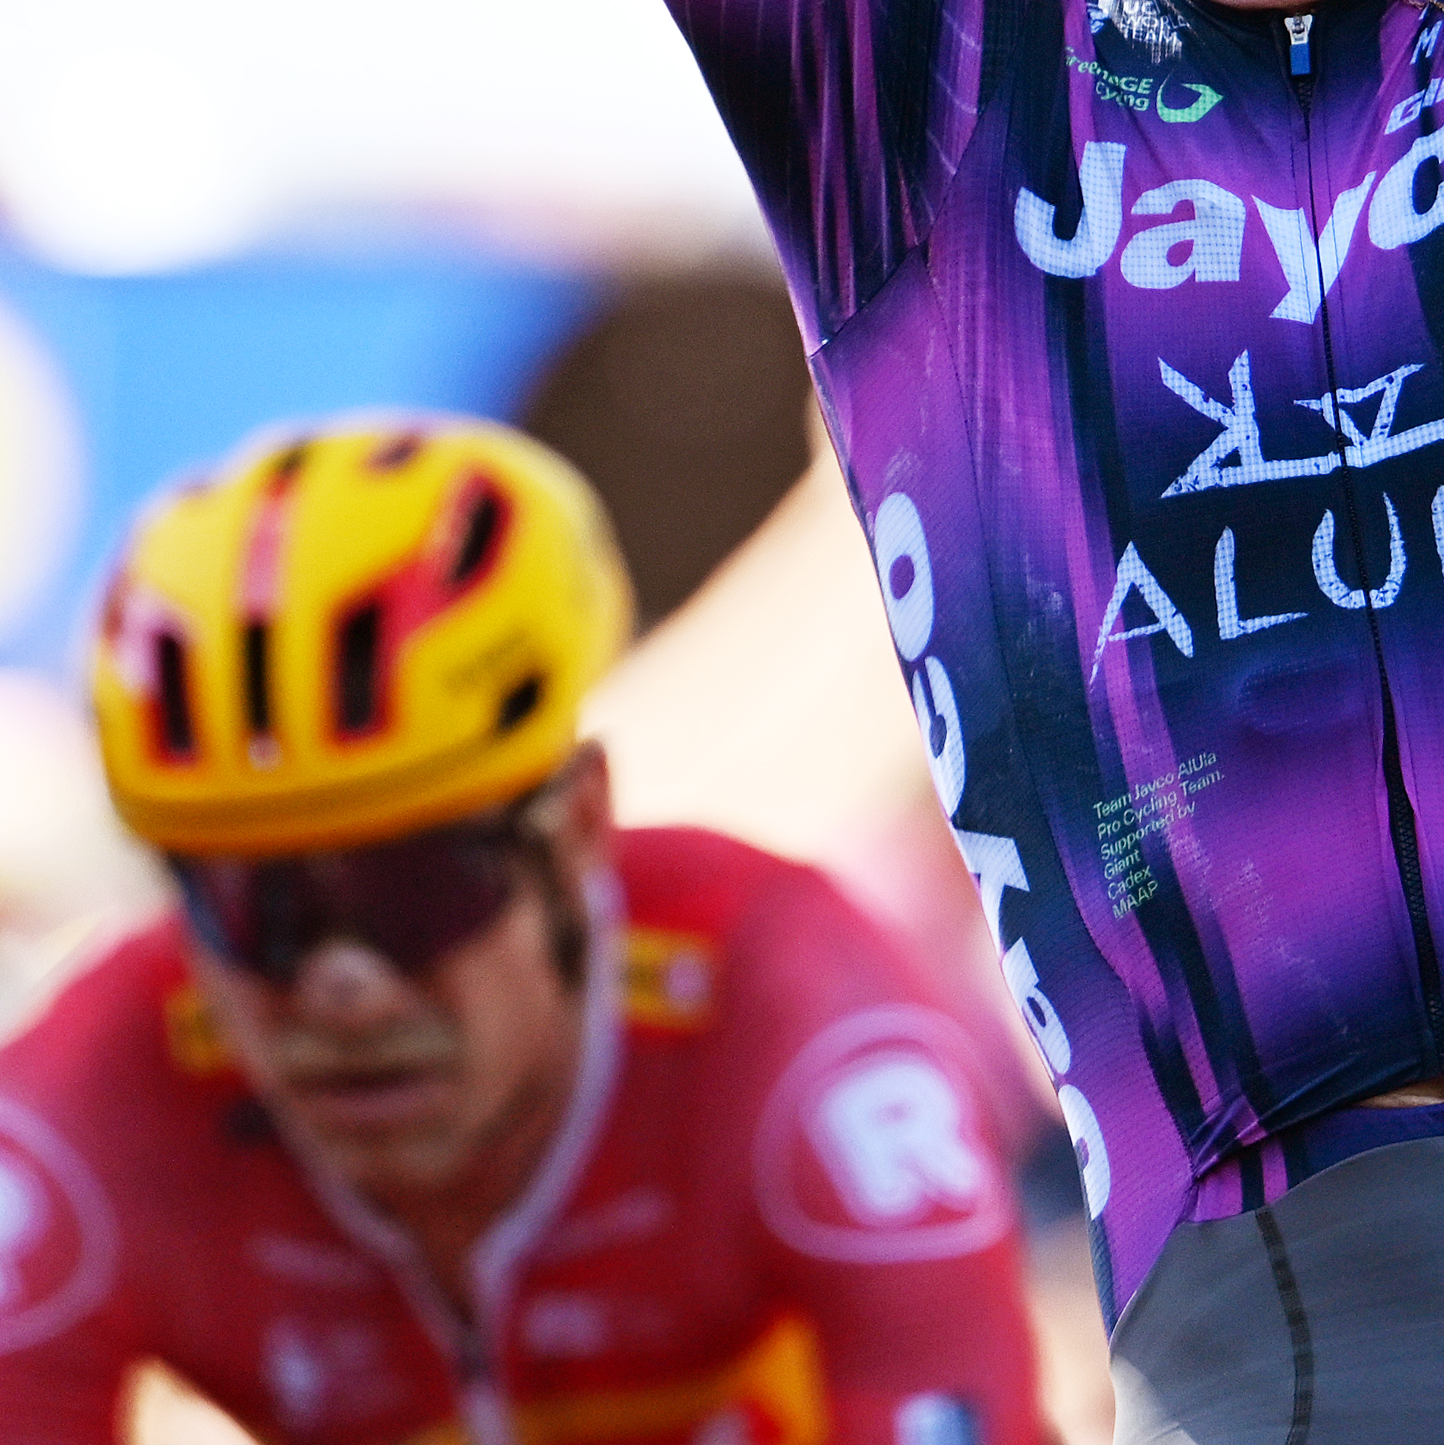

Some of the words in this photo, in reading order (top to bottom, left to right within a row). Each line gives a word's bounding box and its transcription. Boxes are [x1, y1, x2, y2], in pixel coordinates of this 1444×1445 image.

[1093, 793, 1133, 820] Team
[1134, 772, 1174, 800] Jayco
[1097, 819, 1121, 841] Pro
[1123, 790, 1177, 826] Cycling
[1100, 809, 1174, 861] Supported
[1177, 801, 1196, 818] by
[1104, 849, 1141, 880] Giant
[1107, 865, 1153, 901] Cadex
[1112, 880, 1159, 919] MAAP
